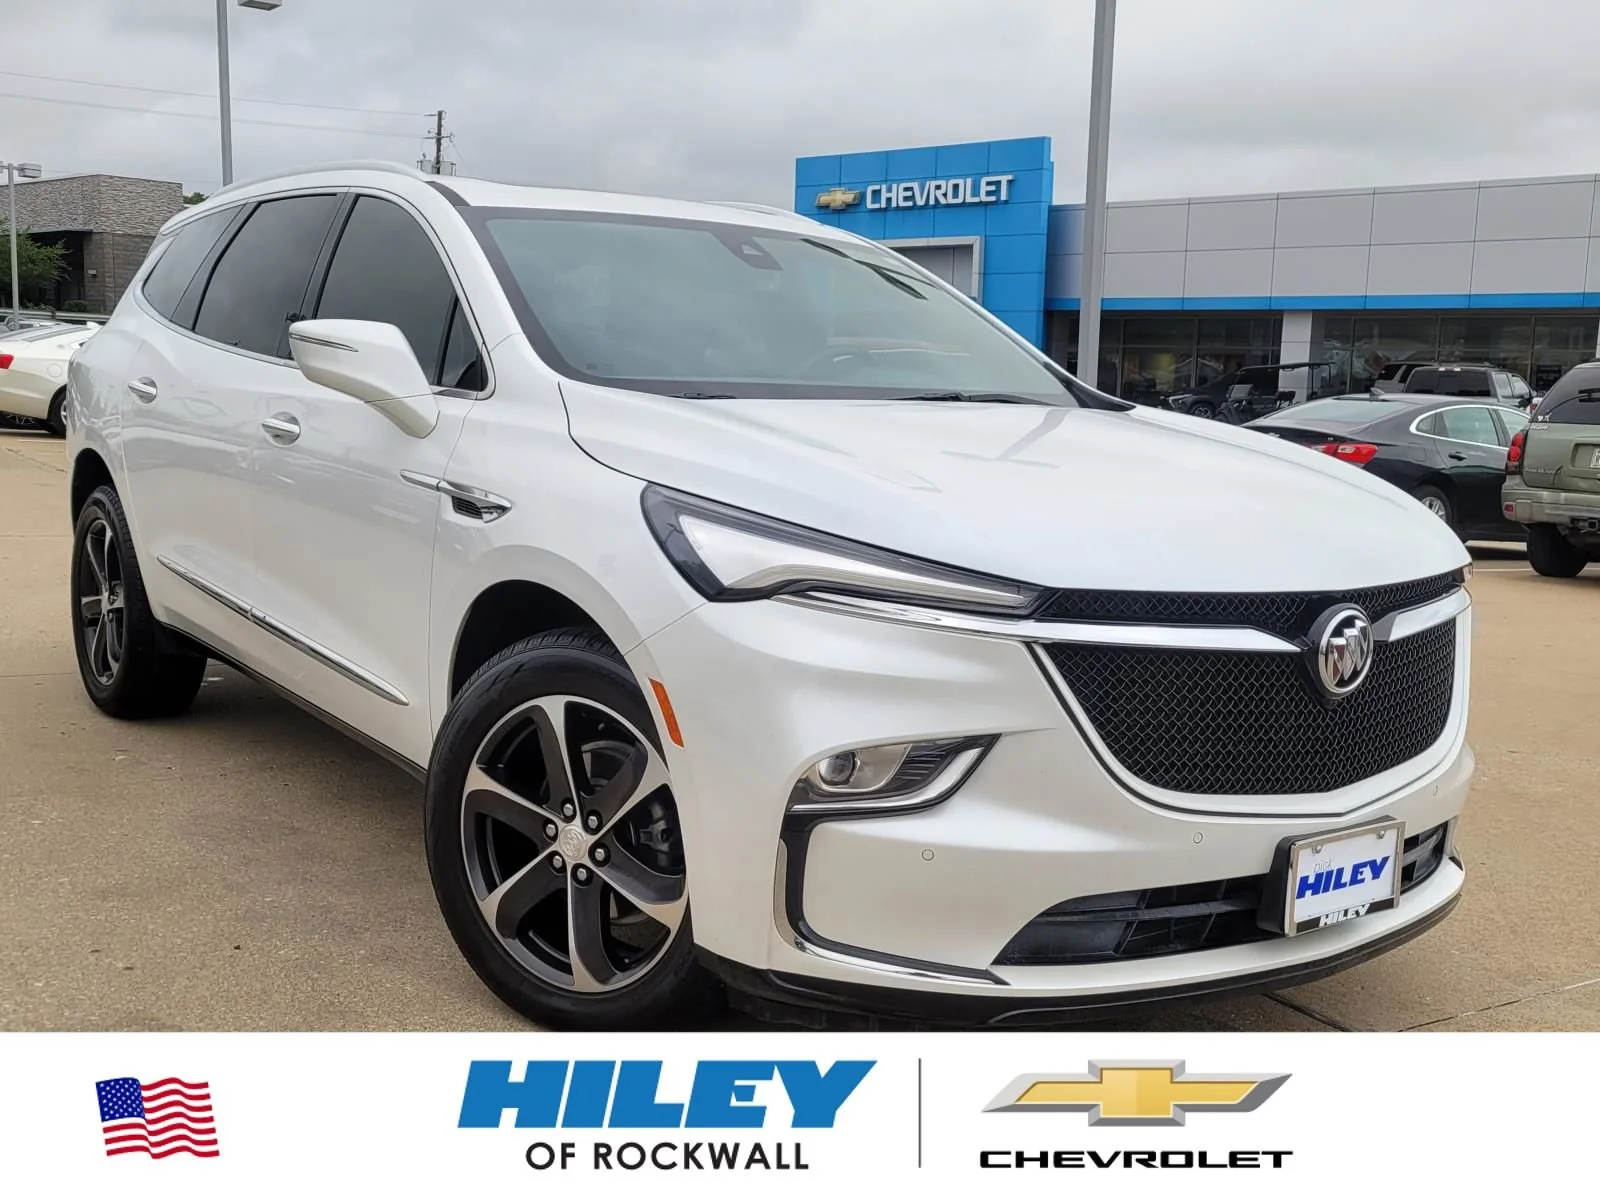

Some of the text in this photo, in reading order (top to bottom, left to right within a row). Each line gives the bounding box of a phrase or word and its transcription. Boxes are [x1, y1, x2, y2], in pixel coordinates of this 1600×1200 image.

[866, 174, 1014, 209] CHEVROLET
[1296, 855, 1391, 900] HILEY
[1319, 903, 1371, 927] HILEY
